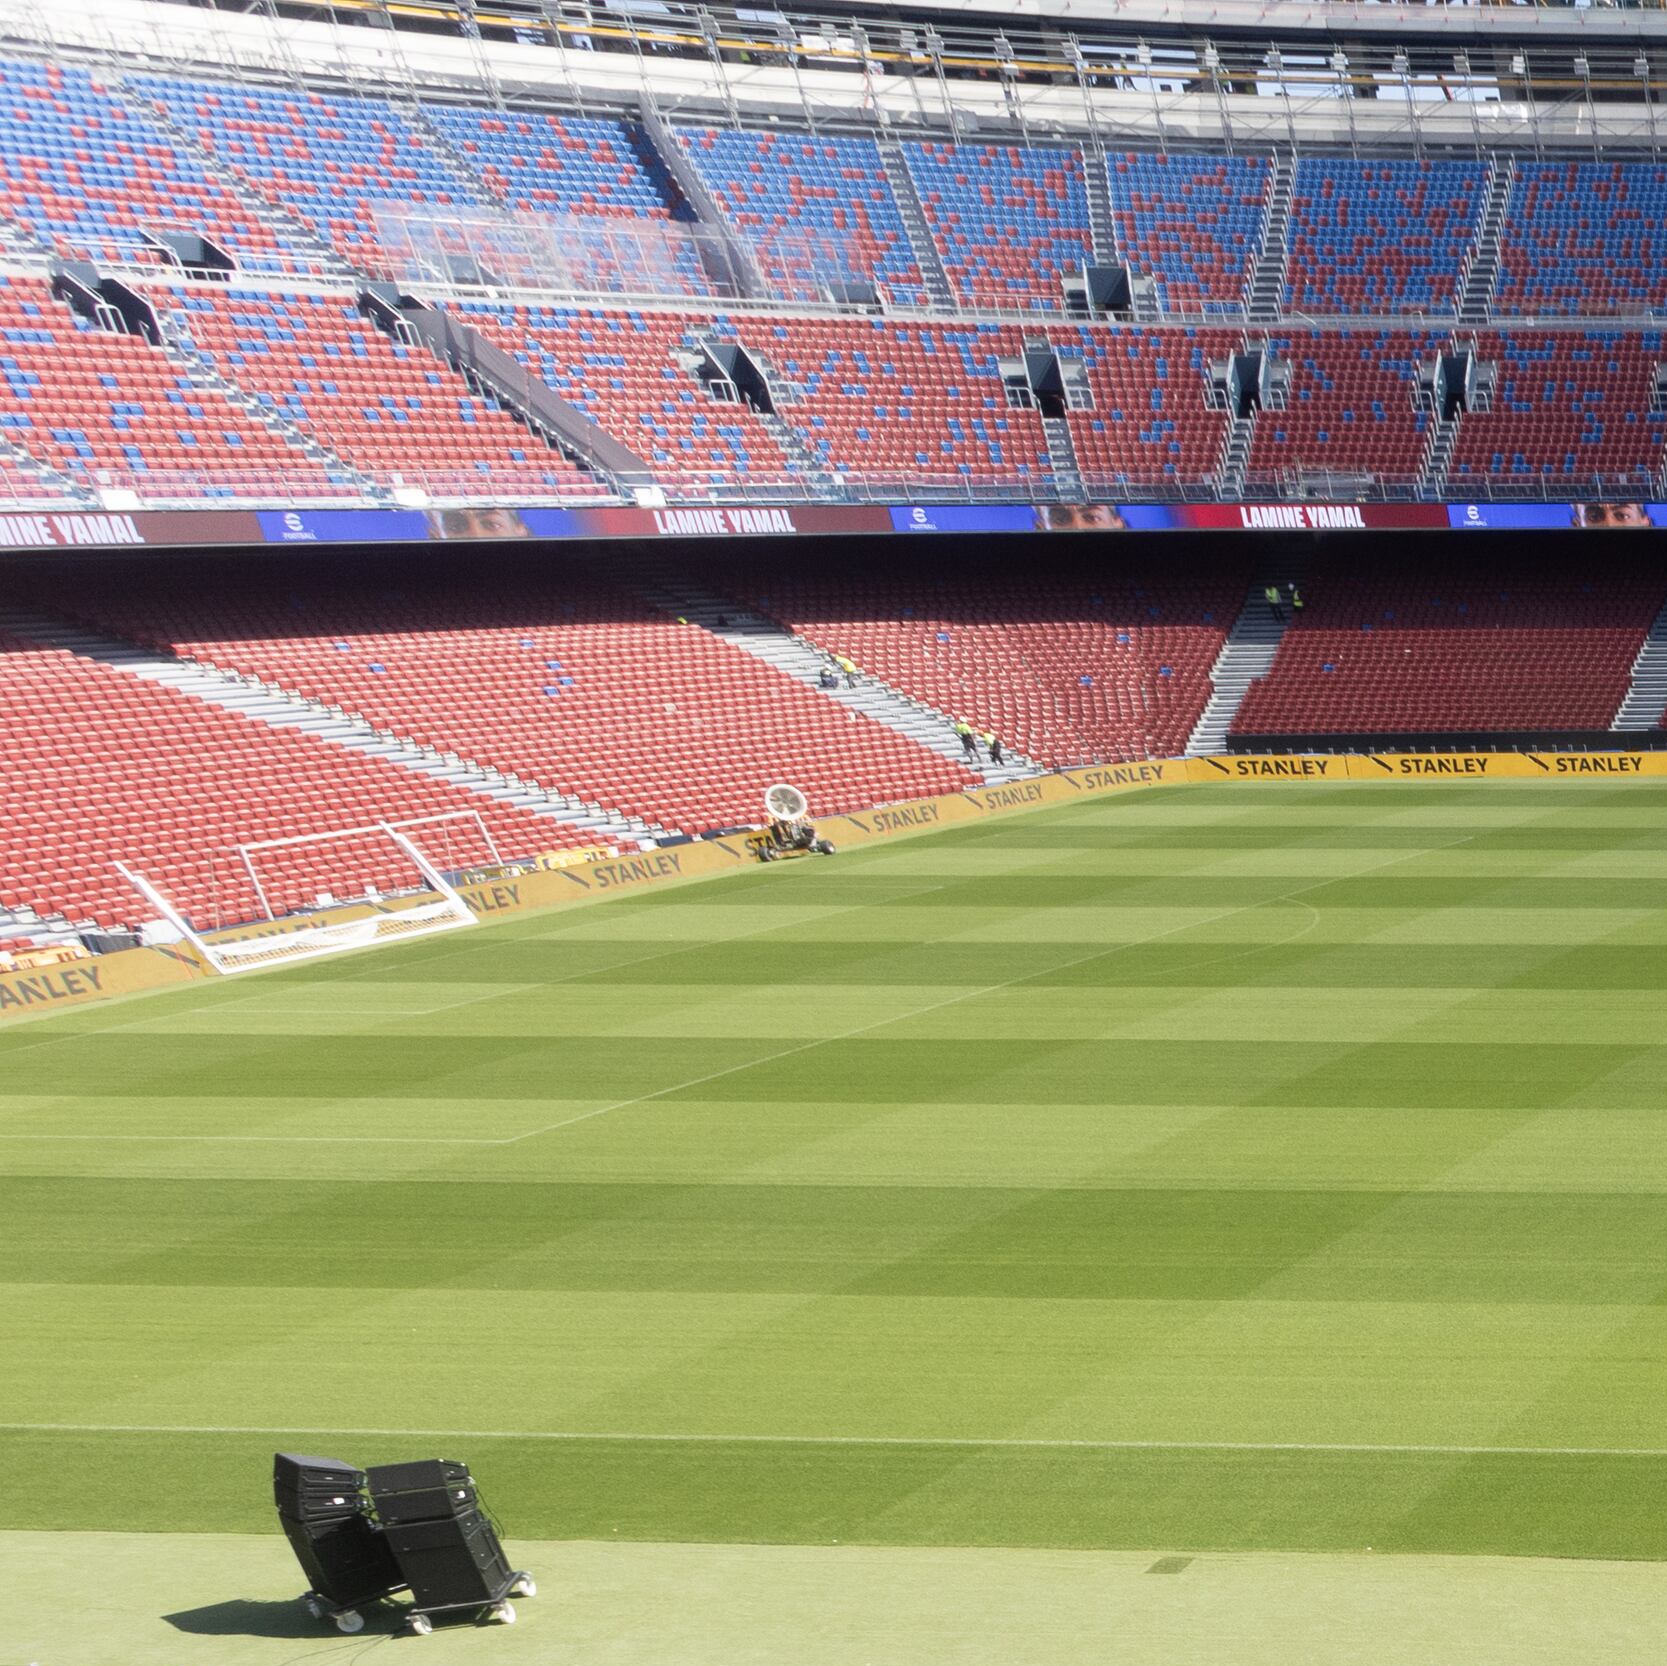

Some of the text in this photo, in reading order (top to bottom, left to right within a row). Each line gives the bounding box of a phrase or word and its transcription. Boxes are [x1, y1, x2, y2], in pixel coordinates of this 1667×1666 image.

[654, 510, 796, 534] LAMINE YAMAL
[1241, 507, 1365, 527] LAMINE YAMAL
[52, 515, 145, 545] YAMAL
[1236, 759, 1328, 776] STANLEY
[1399, 757, 1489, 774] STANLEY
[1555, 756, 1643, 772] STANLEY
[1085, 765, 1163, 789] STANLEY
[985, 783, 1044, 811] STANLEY
[872, 803, 940, 832] STANLEY
[593, 852, 682, 888] STANLEY
